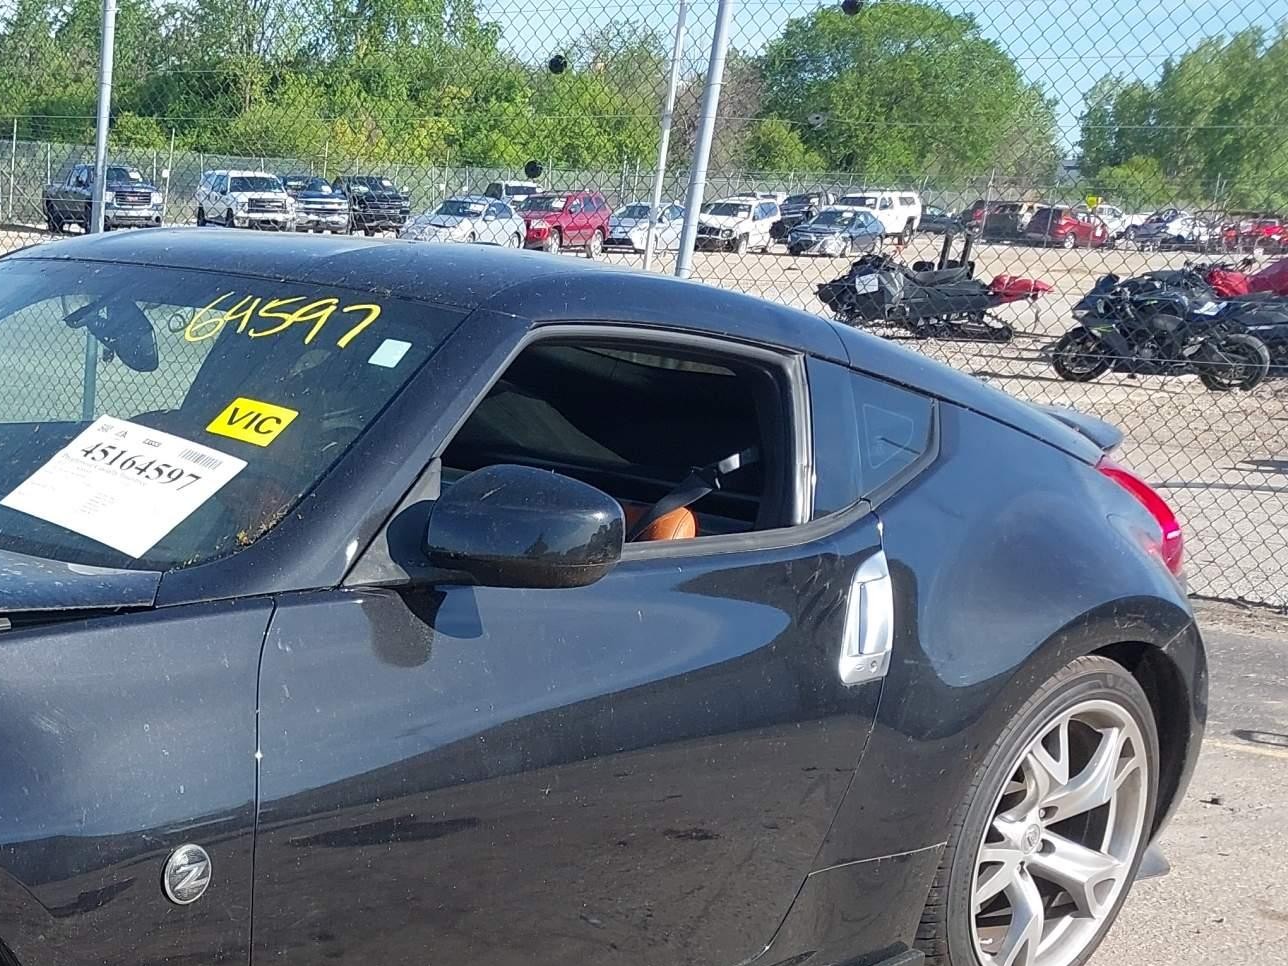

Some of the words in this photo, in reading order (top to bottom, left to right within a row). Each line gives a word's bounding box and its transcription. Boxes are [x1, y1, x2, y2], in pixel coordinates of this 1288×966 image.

[184, 291, 382, 349] 64597
[225, 406, 283, 435] VIC
[80, 441, 203, 492] 45164597
